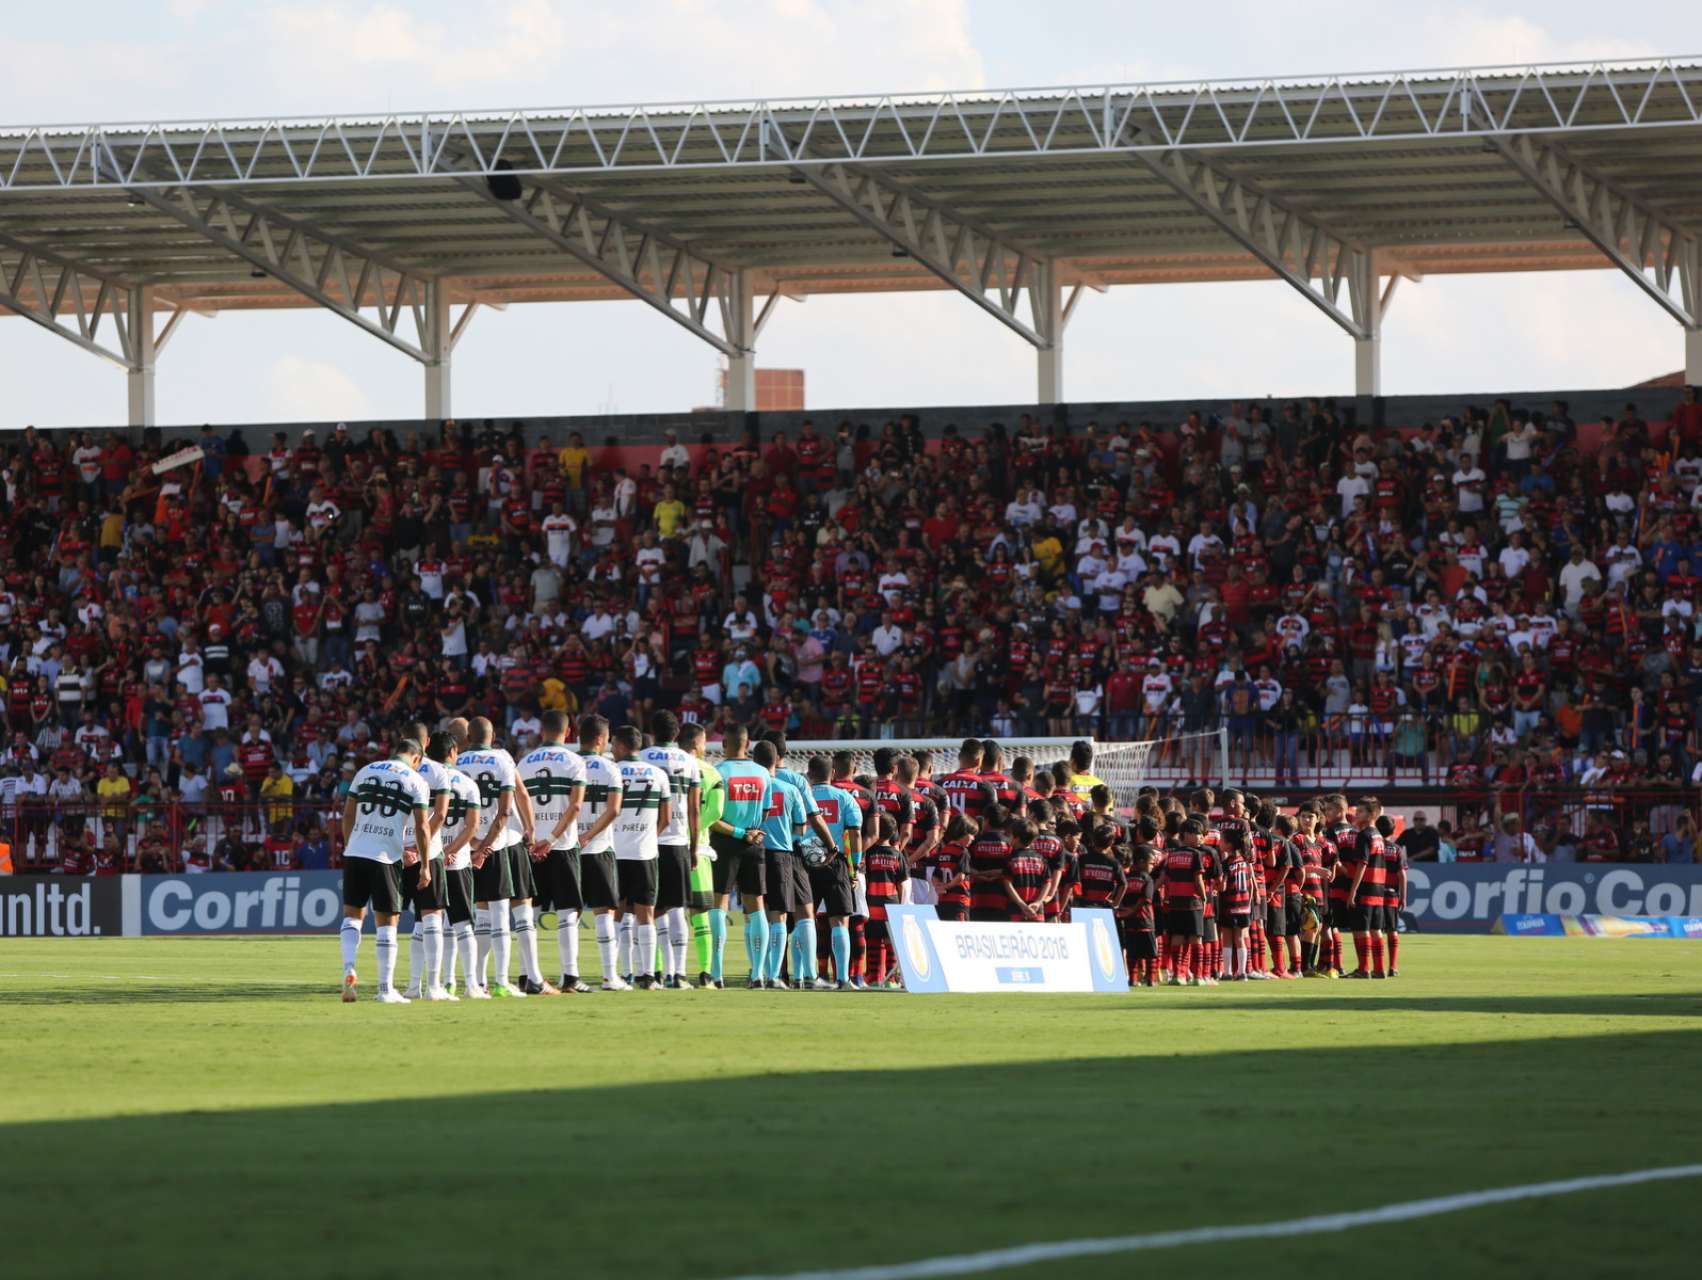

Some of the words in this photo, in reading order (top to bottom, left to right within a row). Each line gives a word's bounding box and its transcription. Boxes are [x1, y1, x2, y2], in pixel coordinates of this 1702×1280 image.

[457, 753, 496, 766] CAIXA
[527, 751, 565, 764] CAIXA
[648, 752, 686, 762] CAIXA
[622, 767, 653, 776] AIXA
[733, 783, 759, 794] TCL
[943, 780, 978, 789] CAIXA
[876, 791, 898, 802] IXA
[819, 806, 832, 816] CL
[1406, 868, 1586, 920] Corfio
[0, 882, 101, 936] nltd.
[148, 876, 339, 931] Corfio
[955, 929, 1038, 960] BRASILEIRÃO
[1038, 936, 1070, 961] 2018
